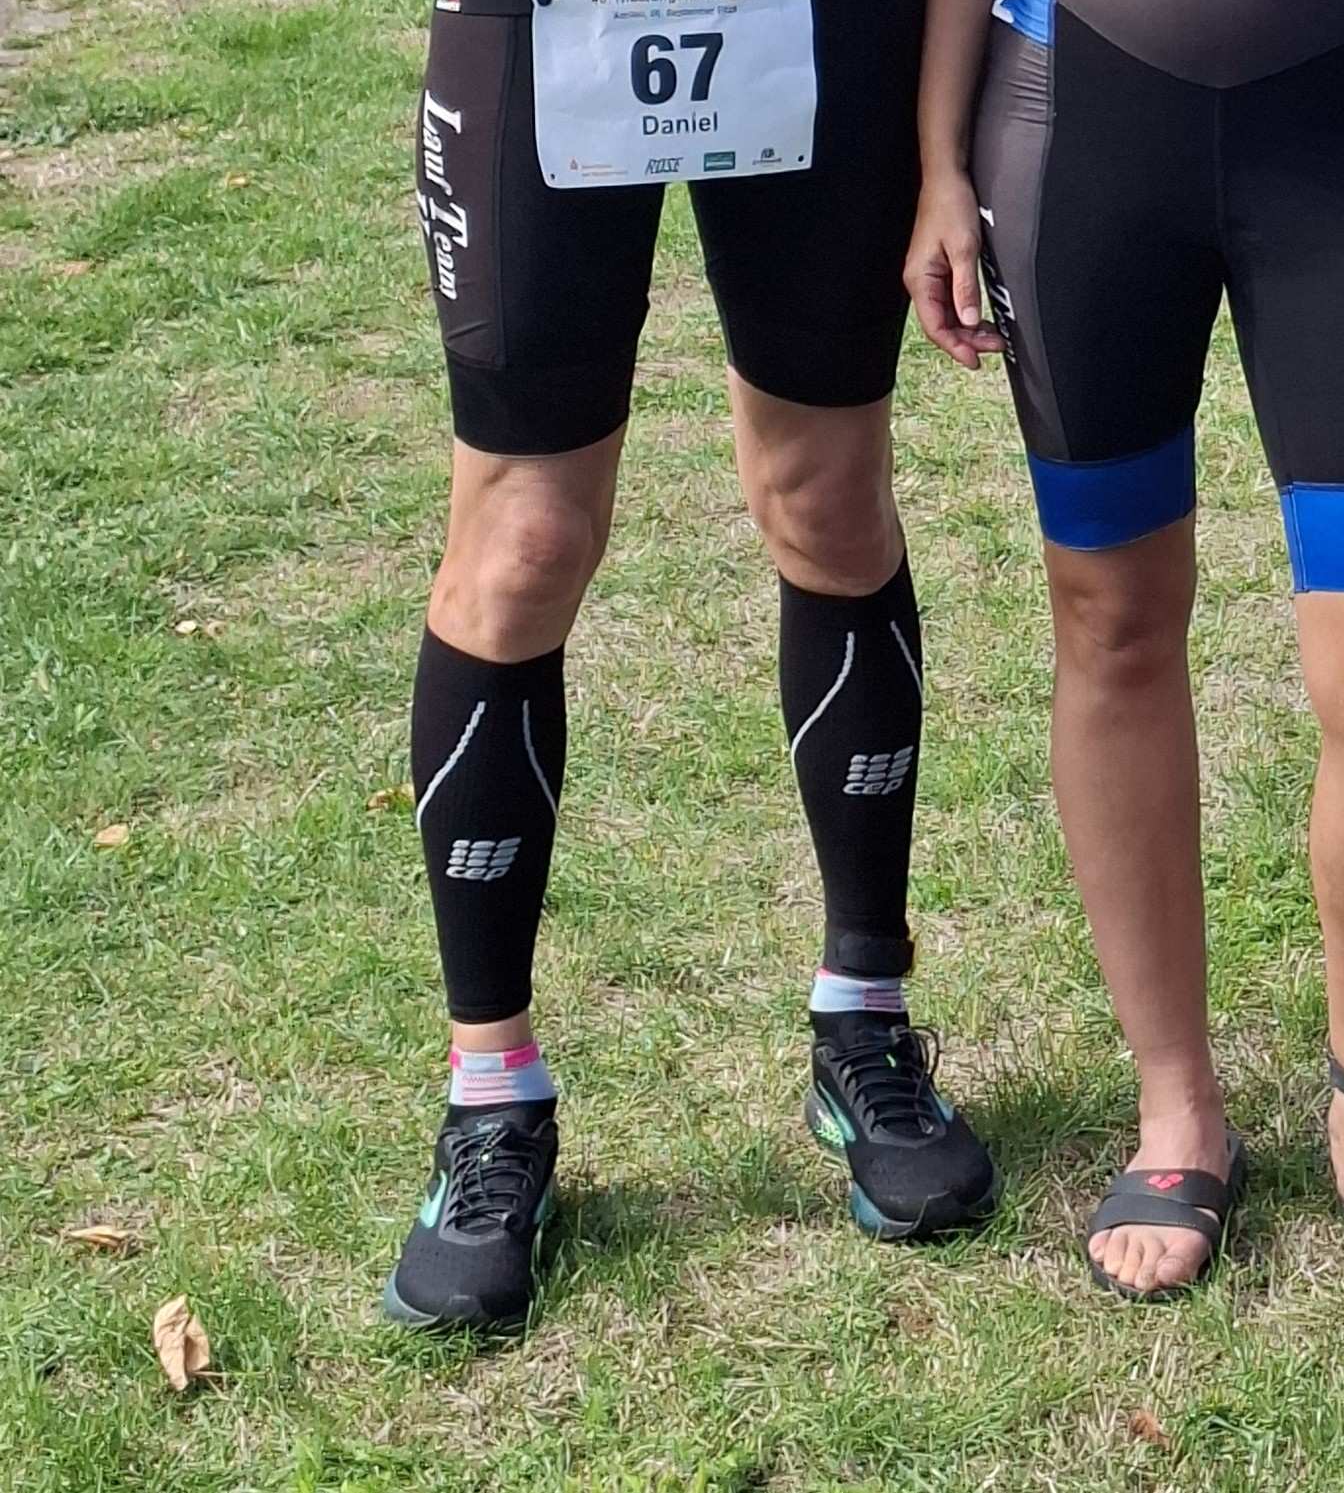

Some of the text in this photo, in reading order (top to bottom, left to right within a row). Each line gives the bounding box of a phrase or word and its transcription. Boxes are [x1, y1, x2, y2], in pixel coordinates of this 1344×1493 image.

[630, 32, 724, 106] 67
[642, 111, 719, 136] Daniel
[645, 157, 684, 176] ROSE
[429, 197, 469, 300] Team
